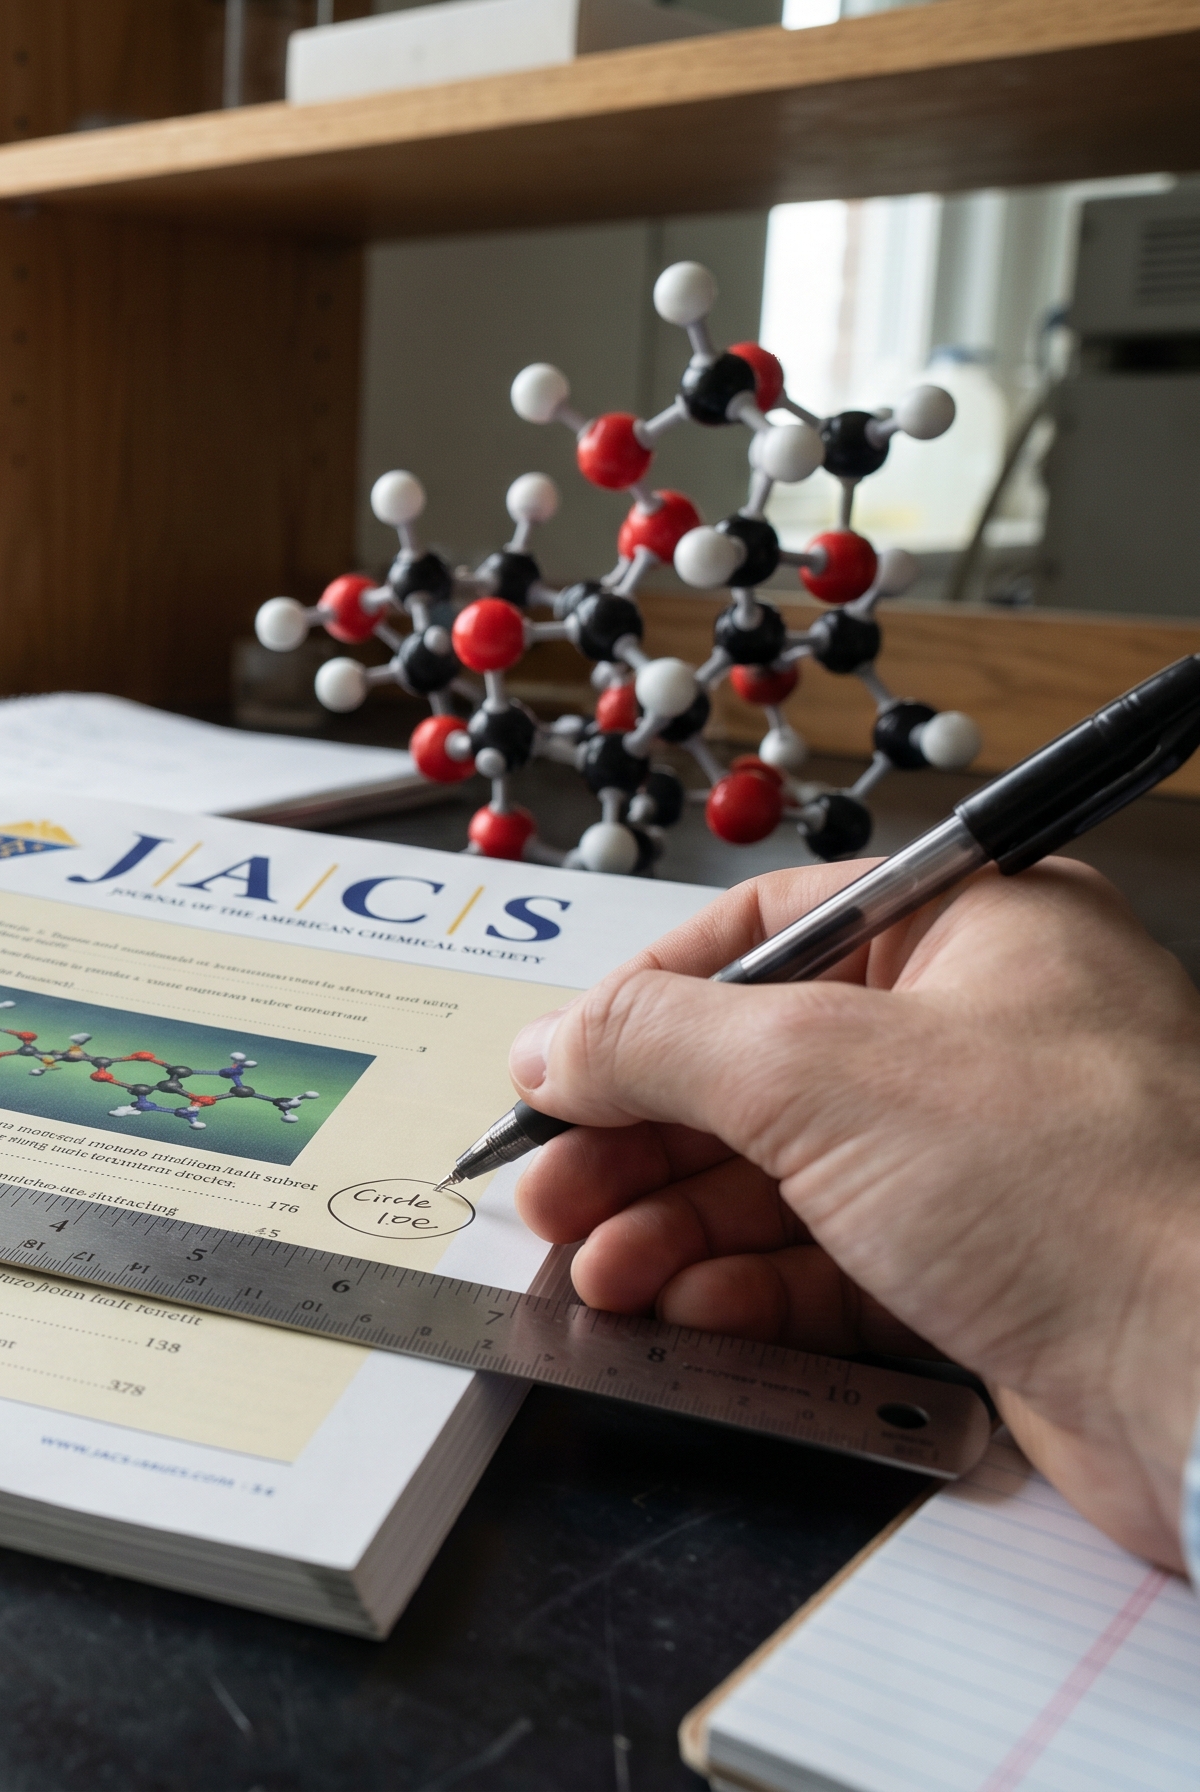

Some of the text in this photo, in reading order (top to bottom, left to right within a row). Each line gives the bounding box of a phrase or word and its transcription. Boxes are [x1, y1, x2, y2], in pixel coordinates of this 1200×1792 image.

[109, 887, 545, 965] JOURNAL OF THE AMERICAN CHEMICAL SOCIETY
[267, 1200, 300, 1214] 176
[353, 1188, 432, 1209] Circle
[48, 1219, 69, 1233] 4
[186, 1248, 208, 1262] 5
[331, 1279, 351, 1294] 6
[485, 1310, 505, 1326] 7
[647, 1346, 667, 1363] 8
[826, 1385, 861, 1406] 10
[145, 1337, 182, 1353] 138
